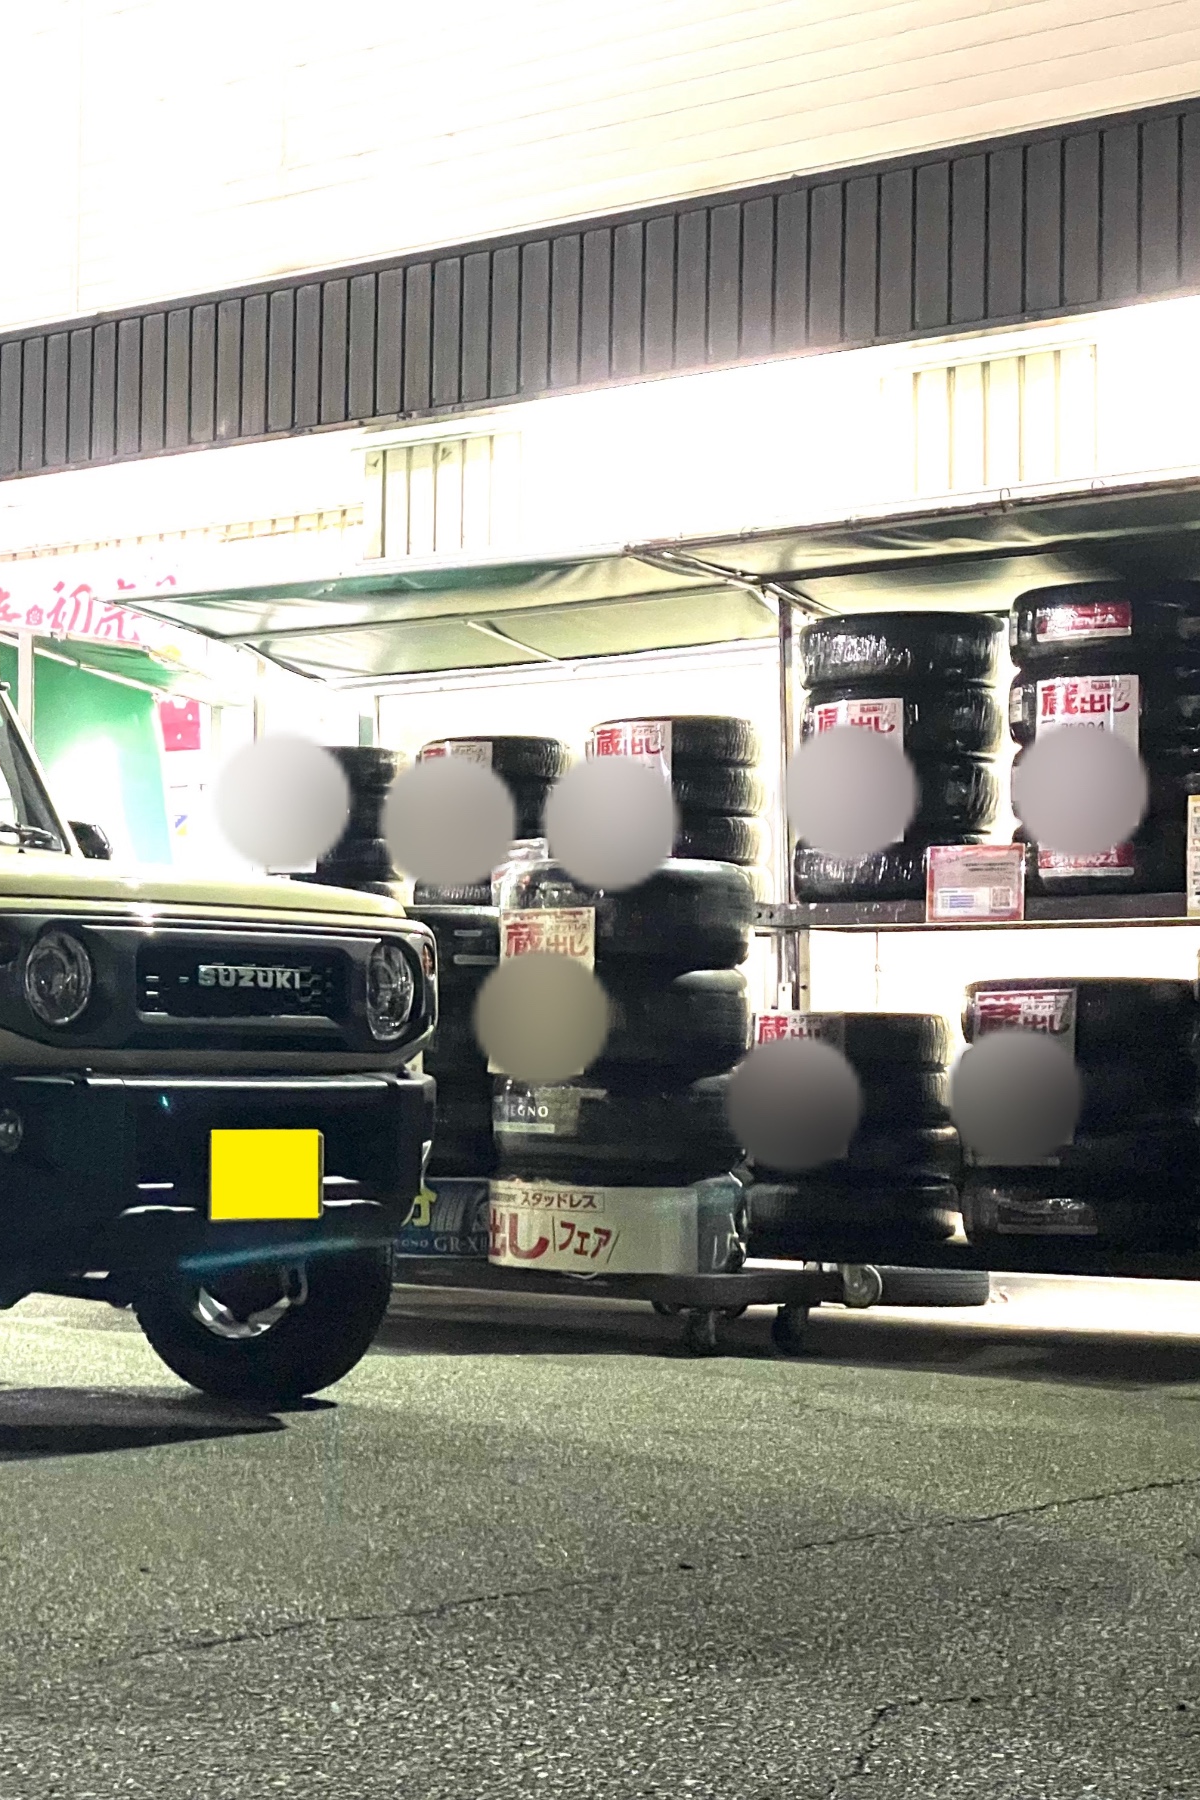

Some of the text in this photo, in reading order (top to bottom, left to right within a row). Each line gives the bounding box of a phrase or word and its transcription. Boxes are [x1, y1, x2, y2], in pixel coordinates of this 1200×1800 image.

[198, 966, 301, 989] SUZUKI
[521, 1191, 598, 1209] スタッドレス
[558, 1219, 612, 1259] フェア
